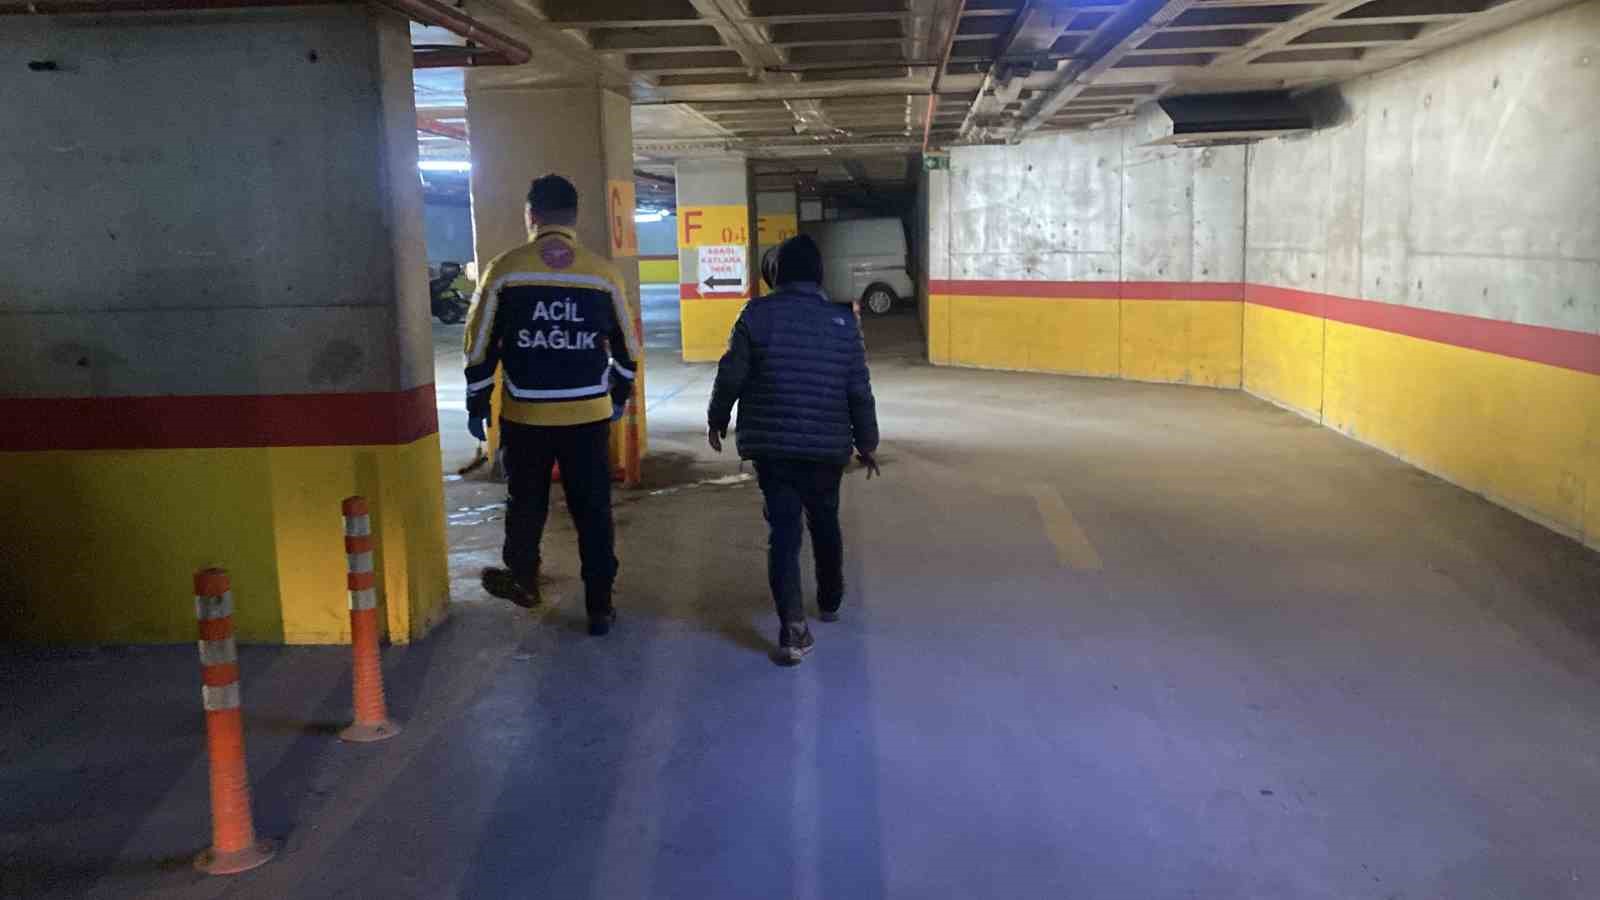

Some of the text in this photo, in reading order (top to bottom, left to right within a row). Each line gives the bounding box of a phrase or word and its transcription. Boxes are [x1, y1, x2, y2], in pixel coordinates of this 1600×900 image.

[684, 210, 747, 244] F 04
[532, 297, 585, 322] ACİL
[517, 325, 598, 350] SAĞLIK
